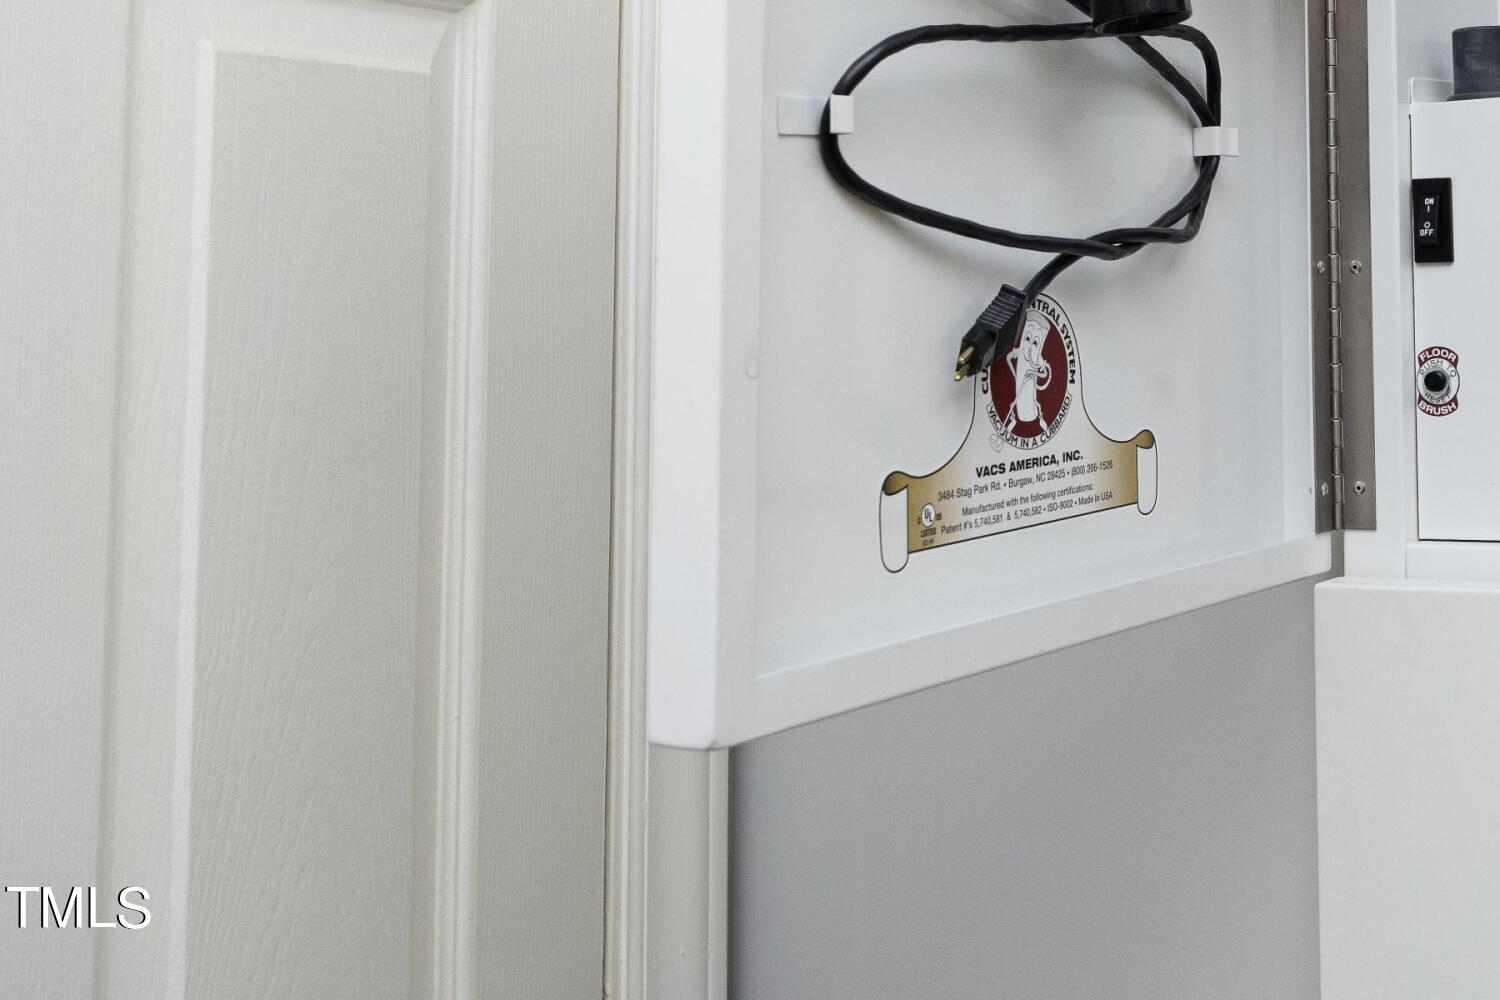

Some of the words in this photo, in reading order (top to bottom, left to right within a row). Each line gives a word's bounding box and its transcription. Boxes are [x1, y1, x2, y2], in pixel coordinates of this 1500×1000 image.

[1424, 197, 1434, 205] ON
[1419, 228, 1434, 236] OFF
[1028, 299, 1060, 326] NTRAL
[1061, 323, 1076, 384] SYSTEM
[1419, 348, 1456, 363] FLOOR
[1420, 358, 1443, 375] PUSH
[1447, 363, 1457, 377] TO
[1419, 400, 1456, 415] BRUSH
[1424, 392, 1451, 403] RESET
[1021, 440, 1029, 448] IN
[1032, 439, 1038, 447] A
[1040, 395, 1070, 442] CUBBARD
[975, 463, 1006, 478] VACS
[1009, 454, 1060, 473] AMERICA,
[1062, 449, 1083, 463] INC.
[956, 487, 972, 498] Stag
[973, 484, 988, 495] Park
[990, 481, 1002, 491] Rd.
[1008, 477, 1035, 488] Burgaw,
[1035, 473, 1046, 482] NC
[1047, 468, 1065, 481] 28425
[1071, 465, 1086, 478] (800)
[962, 500, 1004, 516] Manufactured
[1006, 497, 1018, 507] with
[1019, 494, 1029, 504] the
[1030, 490, 1056, 503] following
[1056, 483, 1094, 497] certifications:
[941, 523, 962, 535] Patent
[1007, 511, 1011, 520] &
[1047, 499, 1073, 512] ISO-9002
[1078, 494, 1094, 505] Made
[1101, 491, 1113, 501] USA
